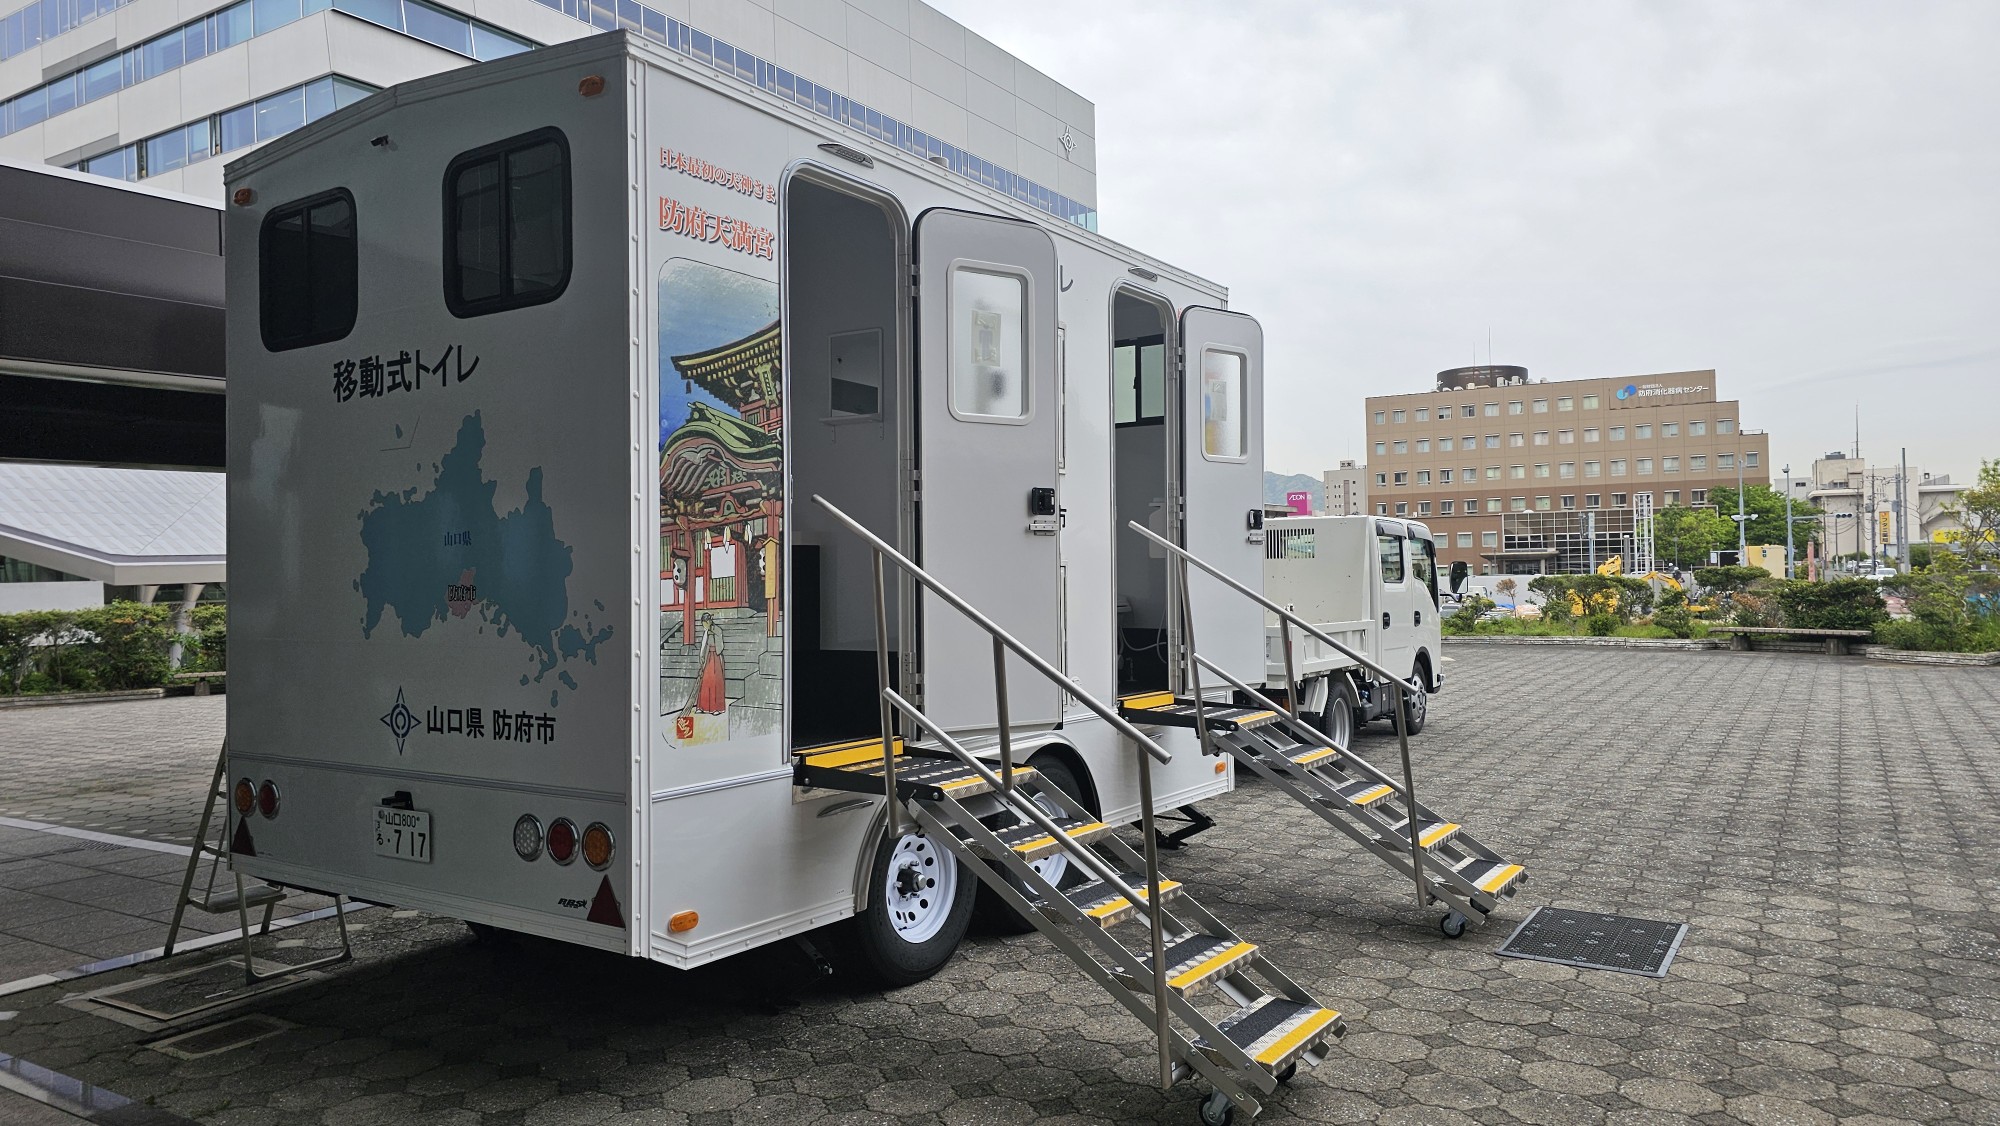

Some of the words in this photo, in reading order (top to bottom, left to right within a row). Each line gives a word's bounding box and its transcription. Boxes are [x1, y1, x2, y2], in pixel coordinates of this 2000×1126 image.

[660, 146, 776, 204] 日本最初の天神さま
[659, 195, 774, 260] 防府天満宮
[333, 344, 480, 403] 移動式トイレ
[444, 530, 472, 547] 山口県
[447, 584, 477, 602] 防府市
[426, 705, 485, 738] 山口県
[492, 709, 557, 744] 防府市
